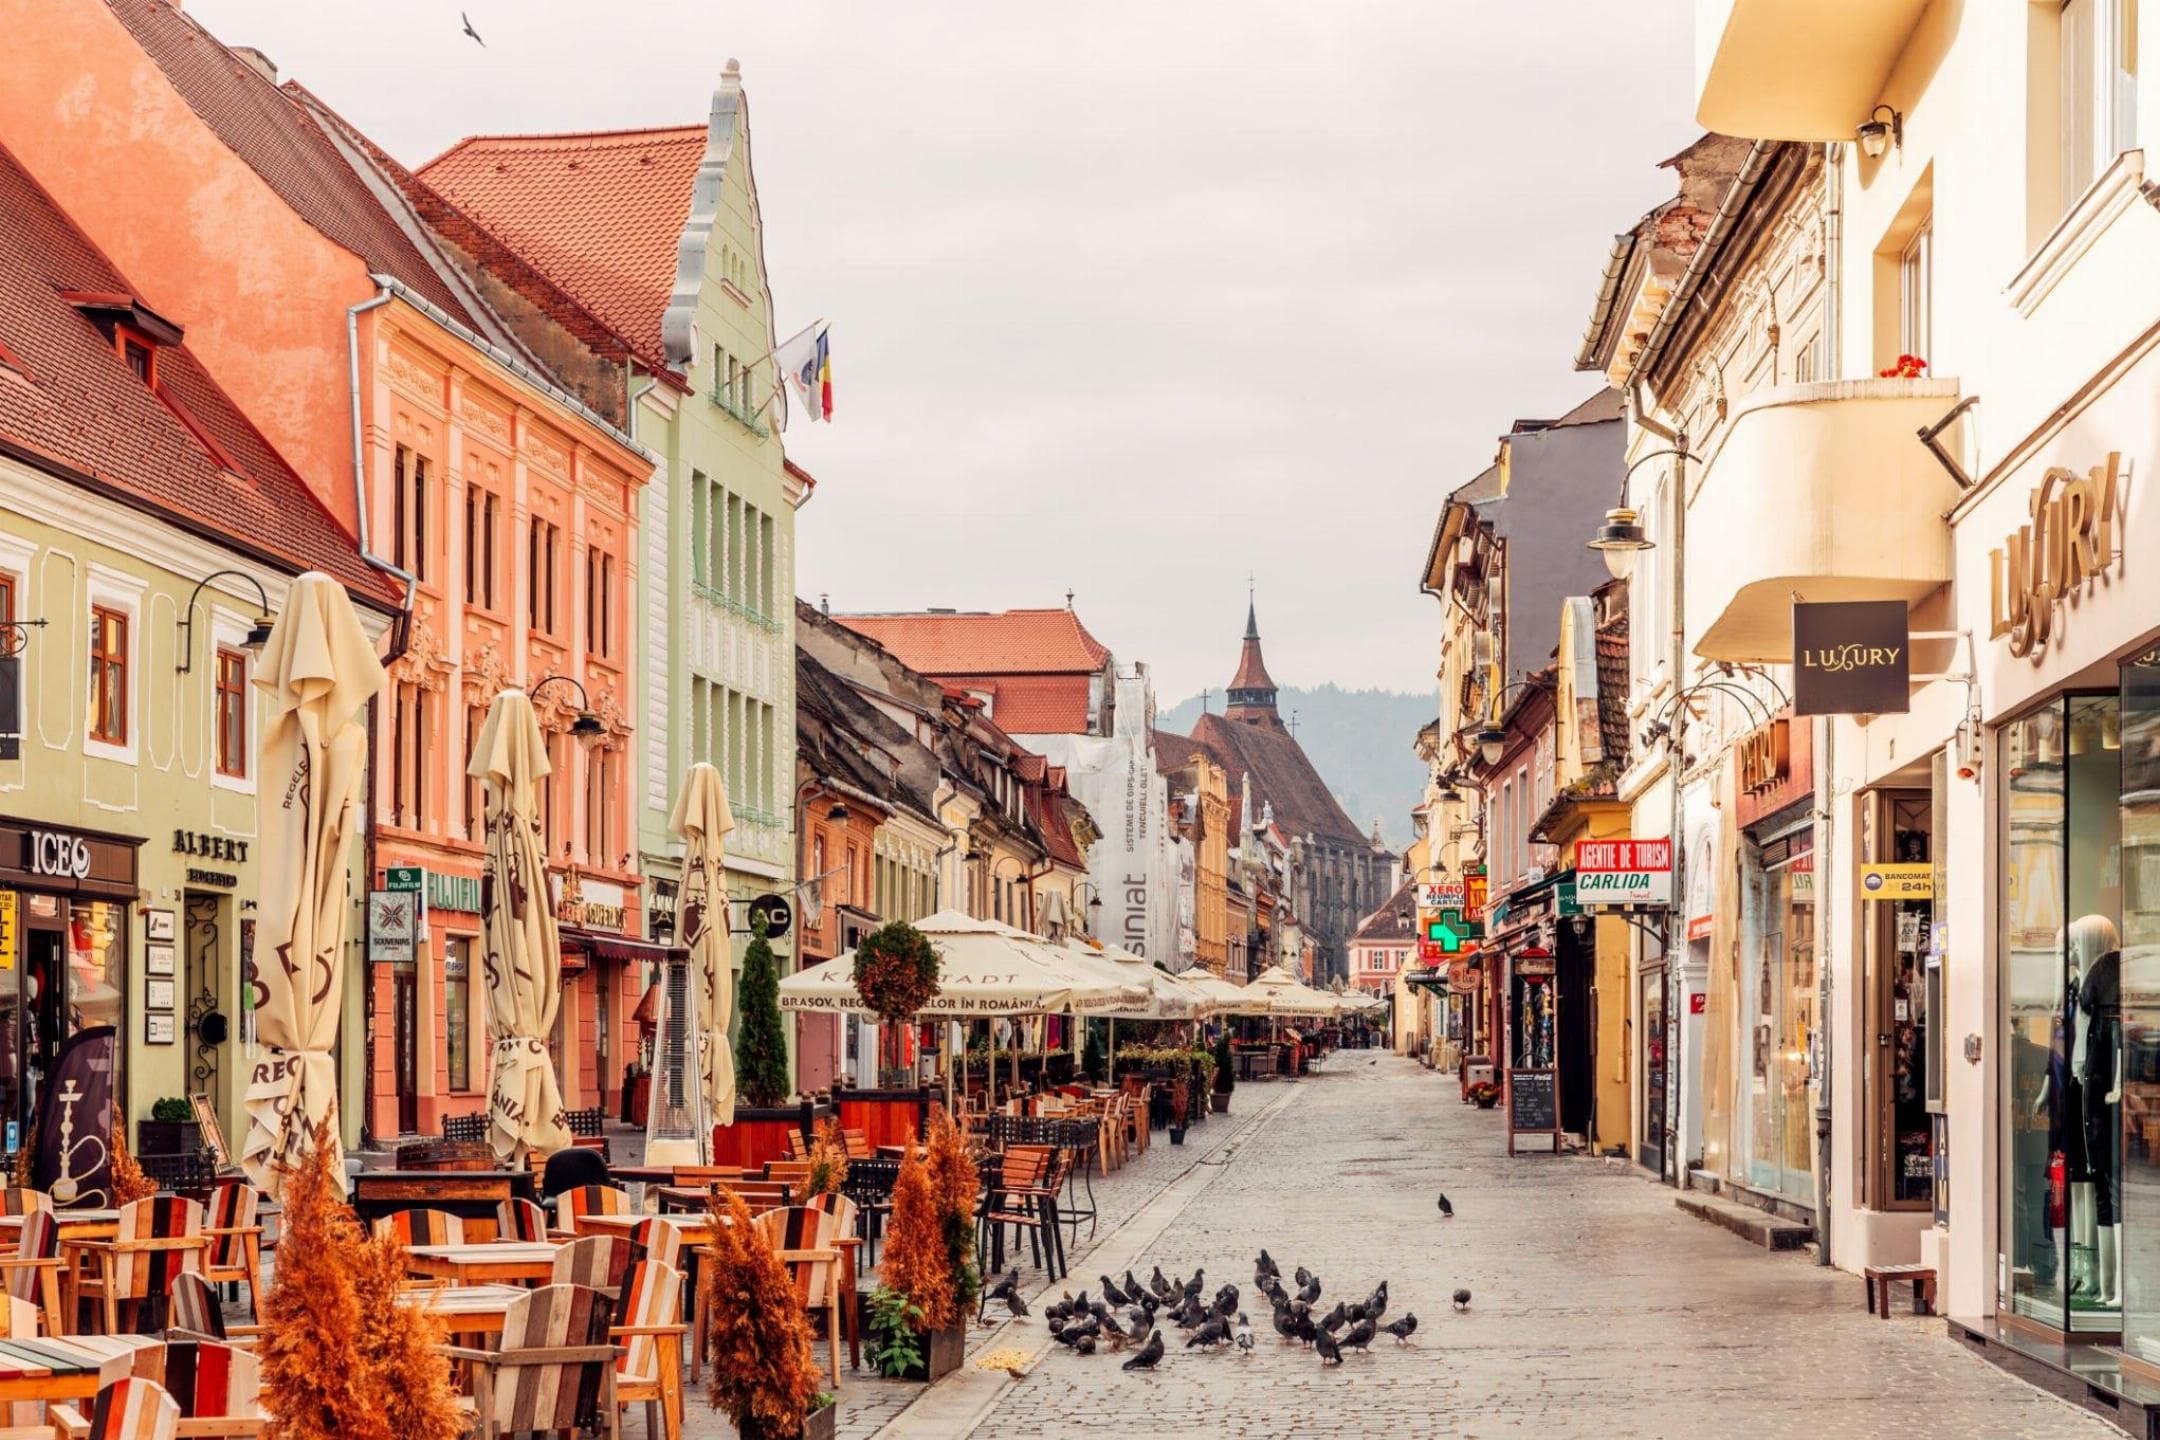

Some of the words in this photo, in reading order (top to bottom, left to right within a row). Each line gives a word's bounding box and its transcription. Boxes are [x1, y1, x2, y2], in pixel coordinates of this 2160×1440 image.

[1989, 451, 2122, 658] LUXURY
[1803, 643, 1900, 672] LUXURY
[1126, 799, 1135, 812] DE
[1125, 813, 1135, 853] SISTEME
[172, 829, 249, 862] ALBERT
[1579, 843, 1616, 868] AGENTIE
[1620, 843, 1632, 868] DE
[1636, 842, 1669, 868] TURISM
[388, 881, 421, 889] FUJIFILM
[1579, 873, 1650, 889] CARLIDA
[1901, 882, 1932, 892] 24h
[1429, 885, 1464, 894] XERO
[961, 996, 975, 1009] ÎN
